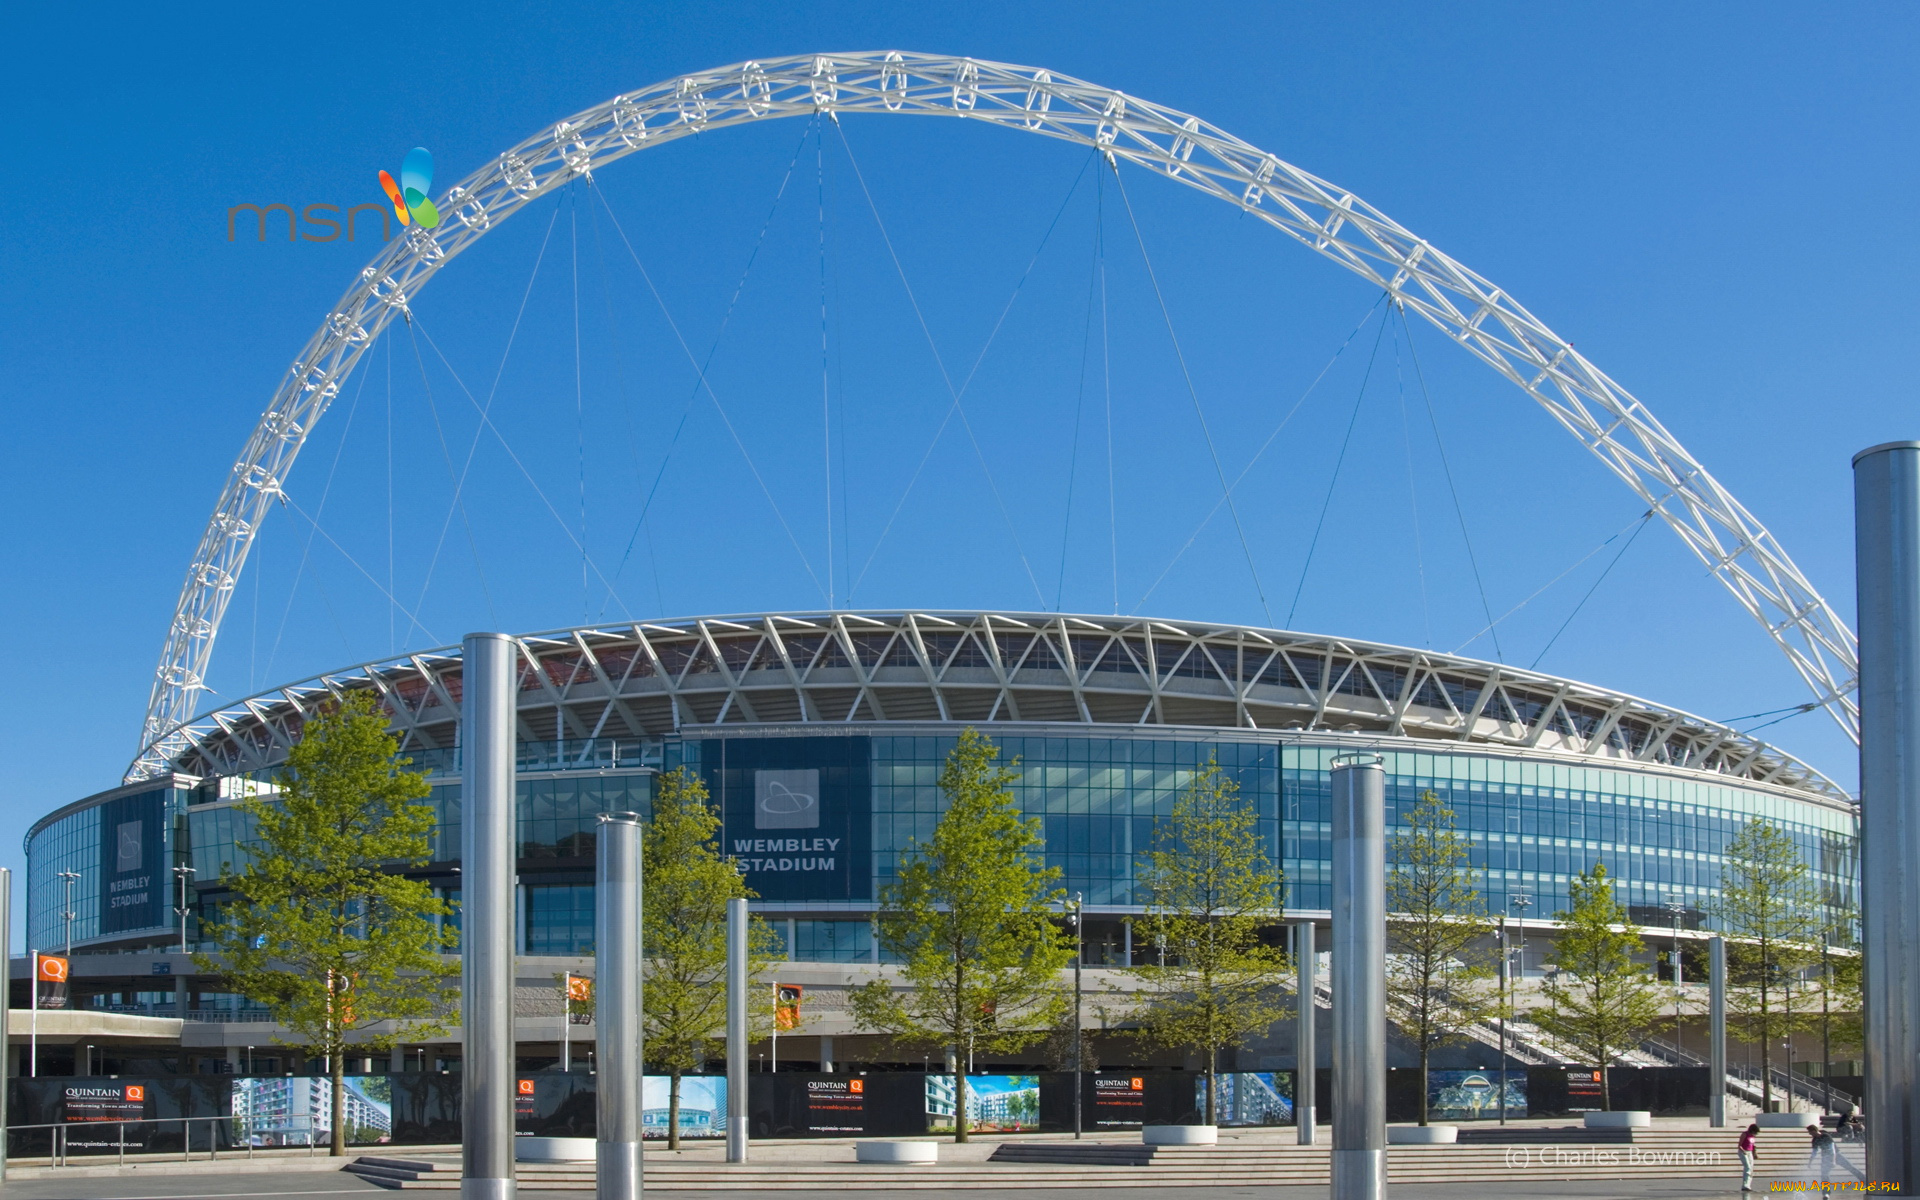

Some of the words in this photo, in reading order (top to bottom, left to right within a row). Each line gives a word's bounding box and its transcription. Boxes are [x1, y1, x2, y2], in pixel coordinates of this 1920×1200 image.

[734, 838, 840, 853] WEMBLEY
[737, 857, 835, 872] STADIUM
[110, 876, 150, 893] WEMBLEY
[111, 892, 148, 909] STADIUM
[42, 959, 64, 979] Q
[851, 1080, 863, 1091] Q
[1132, 1078, 1143, 1088] Q
[66, 1088, 120, 1097] QUINTAIN
[127, 1086, 143, 1099] Q
